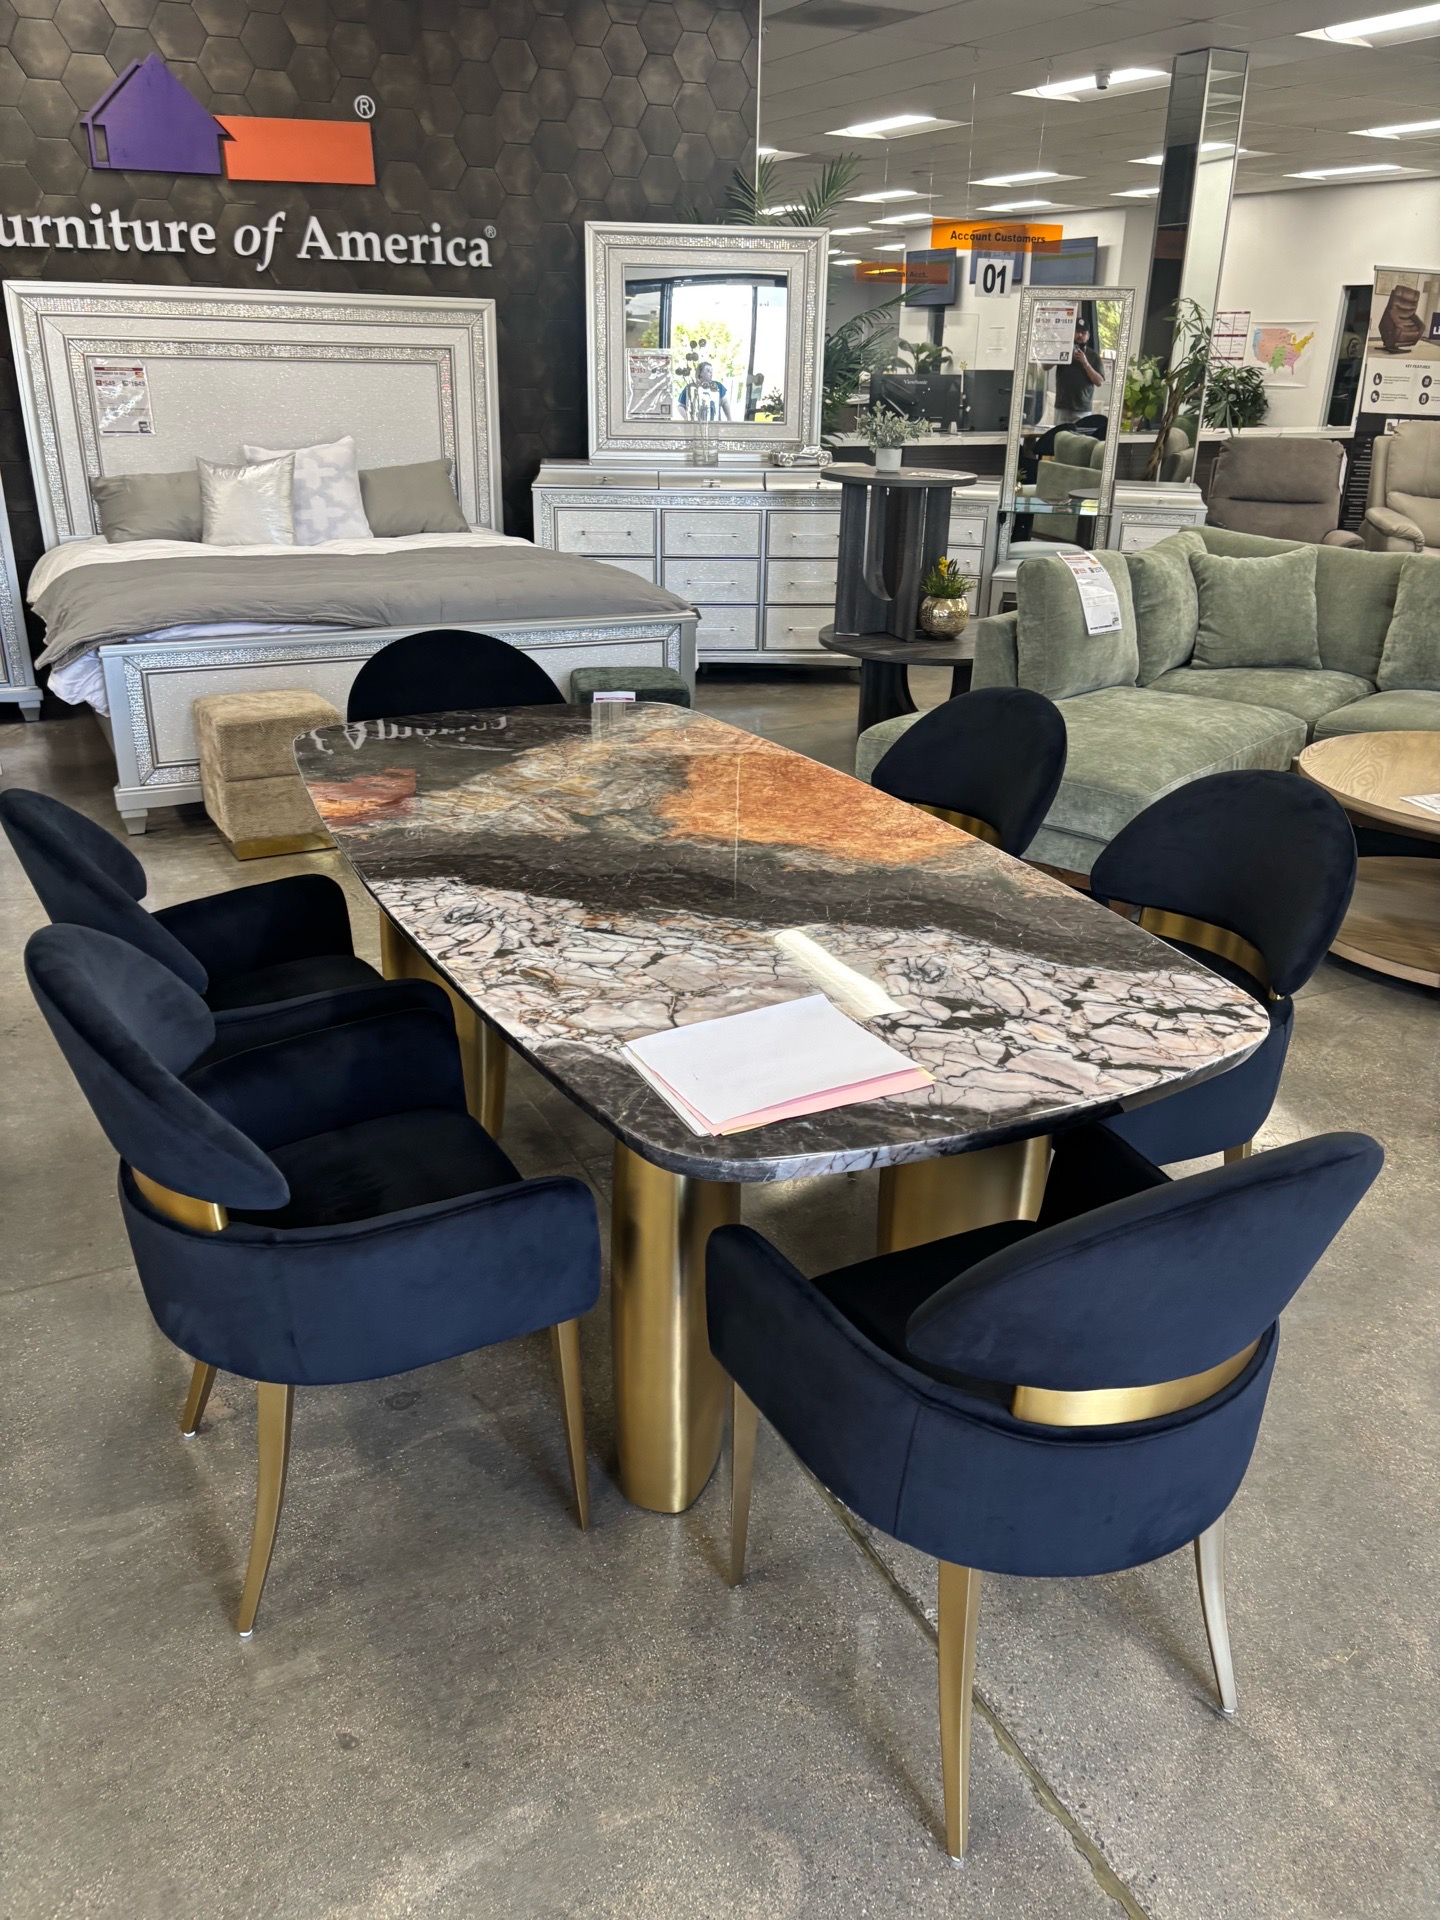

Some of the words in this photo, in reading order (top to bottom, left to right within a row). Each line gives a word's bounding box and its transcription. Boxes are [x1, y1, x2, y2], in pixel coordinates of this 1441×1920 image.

[0, 202, 216, 255] urniture
[233, 211, 286, 272] of
[950, 230, 992, 241] Account
[994, 232, 1046, 244] Customers
[982, 263, 1007, 294] 01
